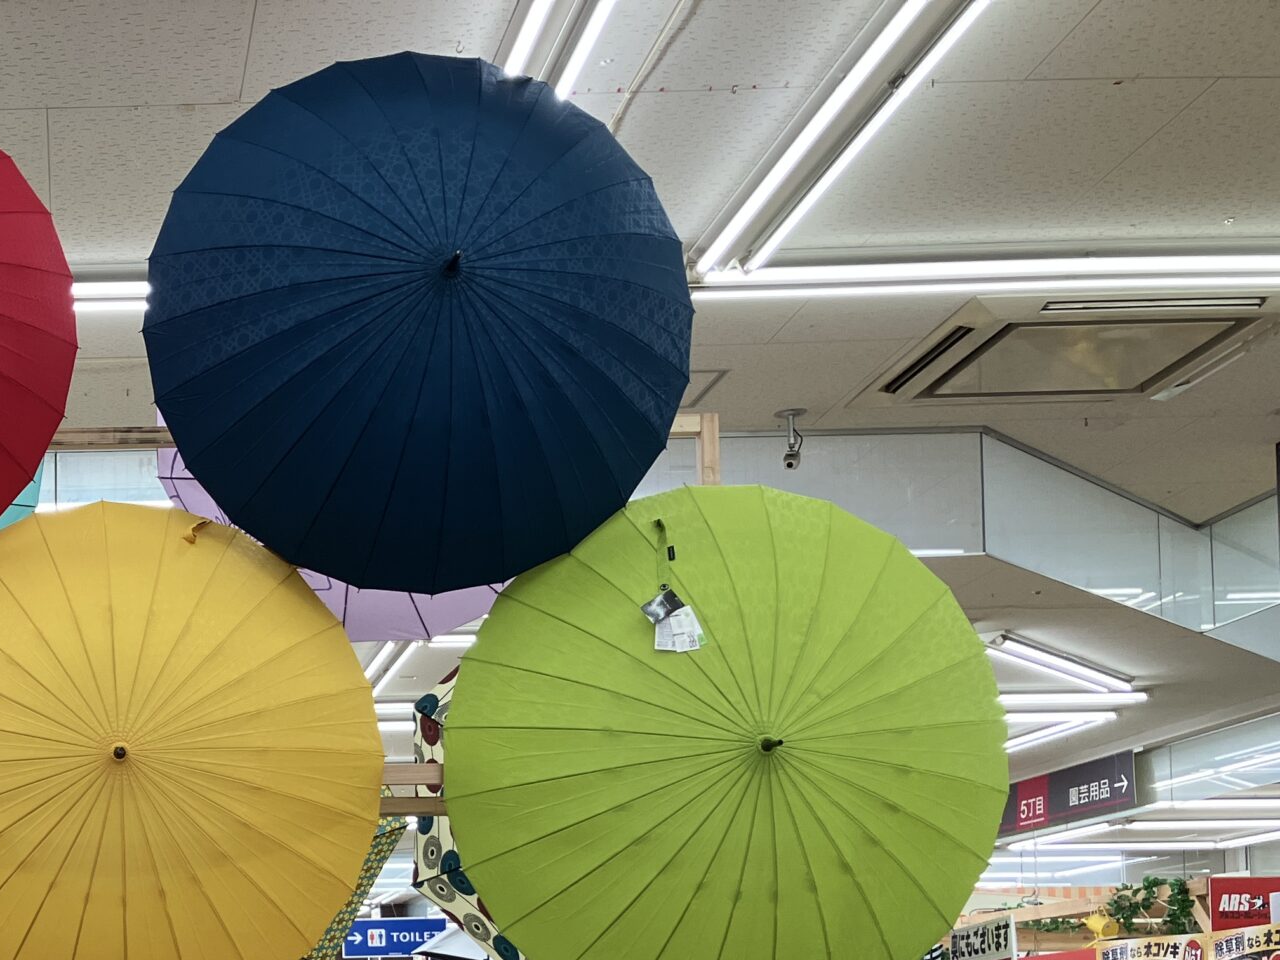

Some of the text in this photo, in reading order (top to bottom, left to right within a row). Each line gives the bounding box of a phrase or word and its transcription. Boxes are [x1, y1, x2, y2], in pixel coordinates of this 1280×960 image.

[1069, 779, 1111, 806] 園芸用品
[1020, 796, 1044, 819] 5丁目
